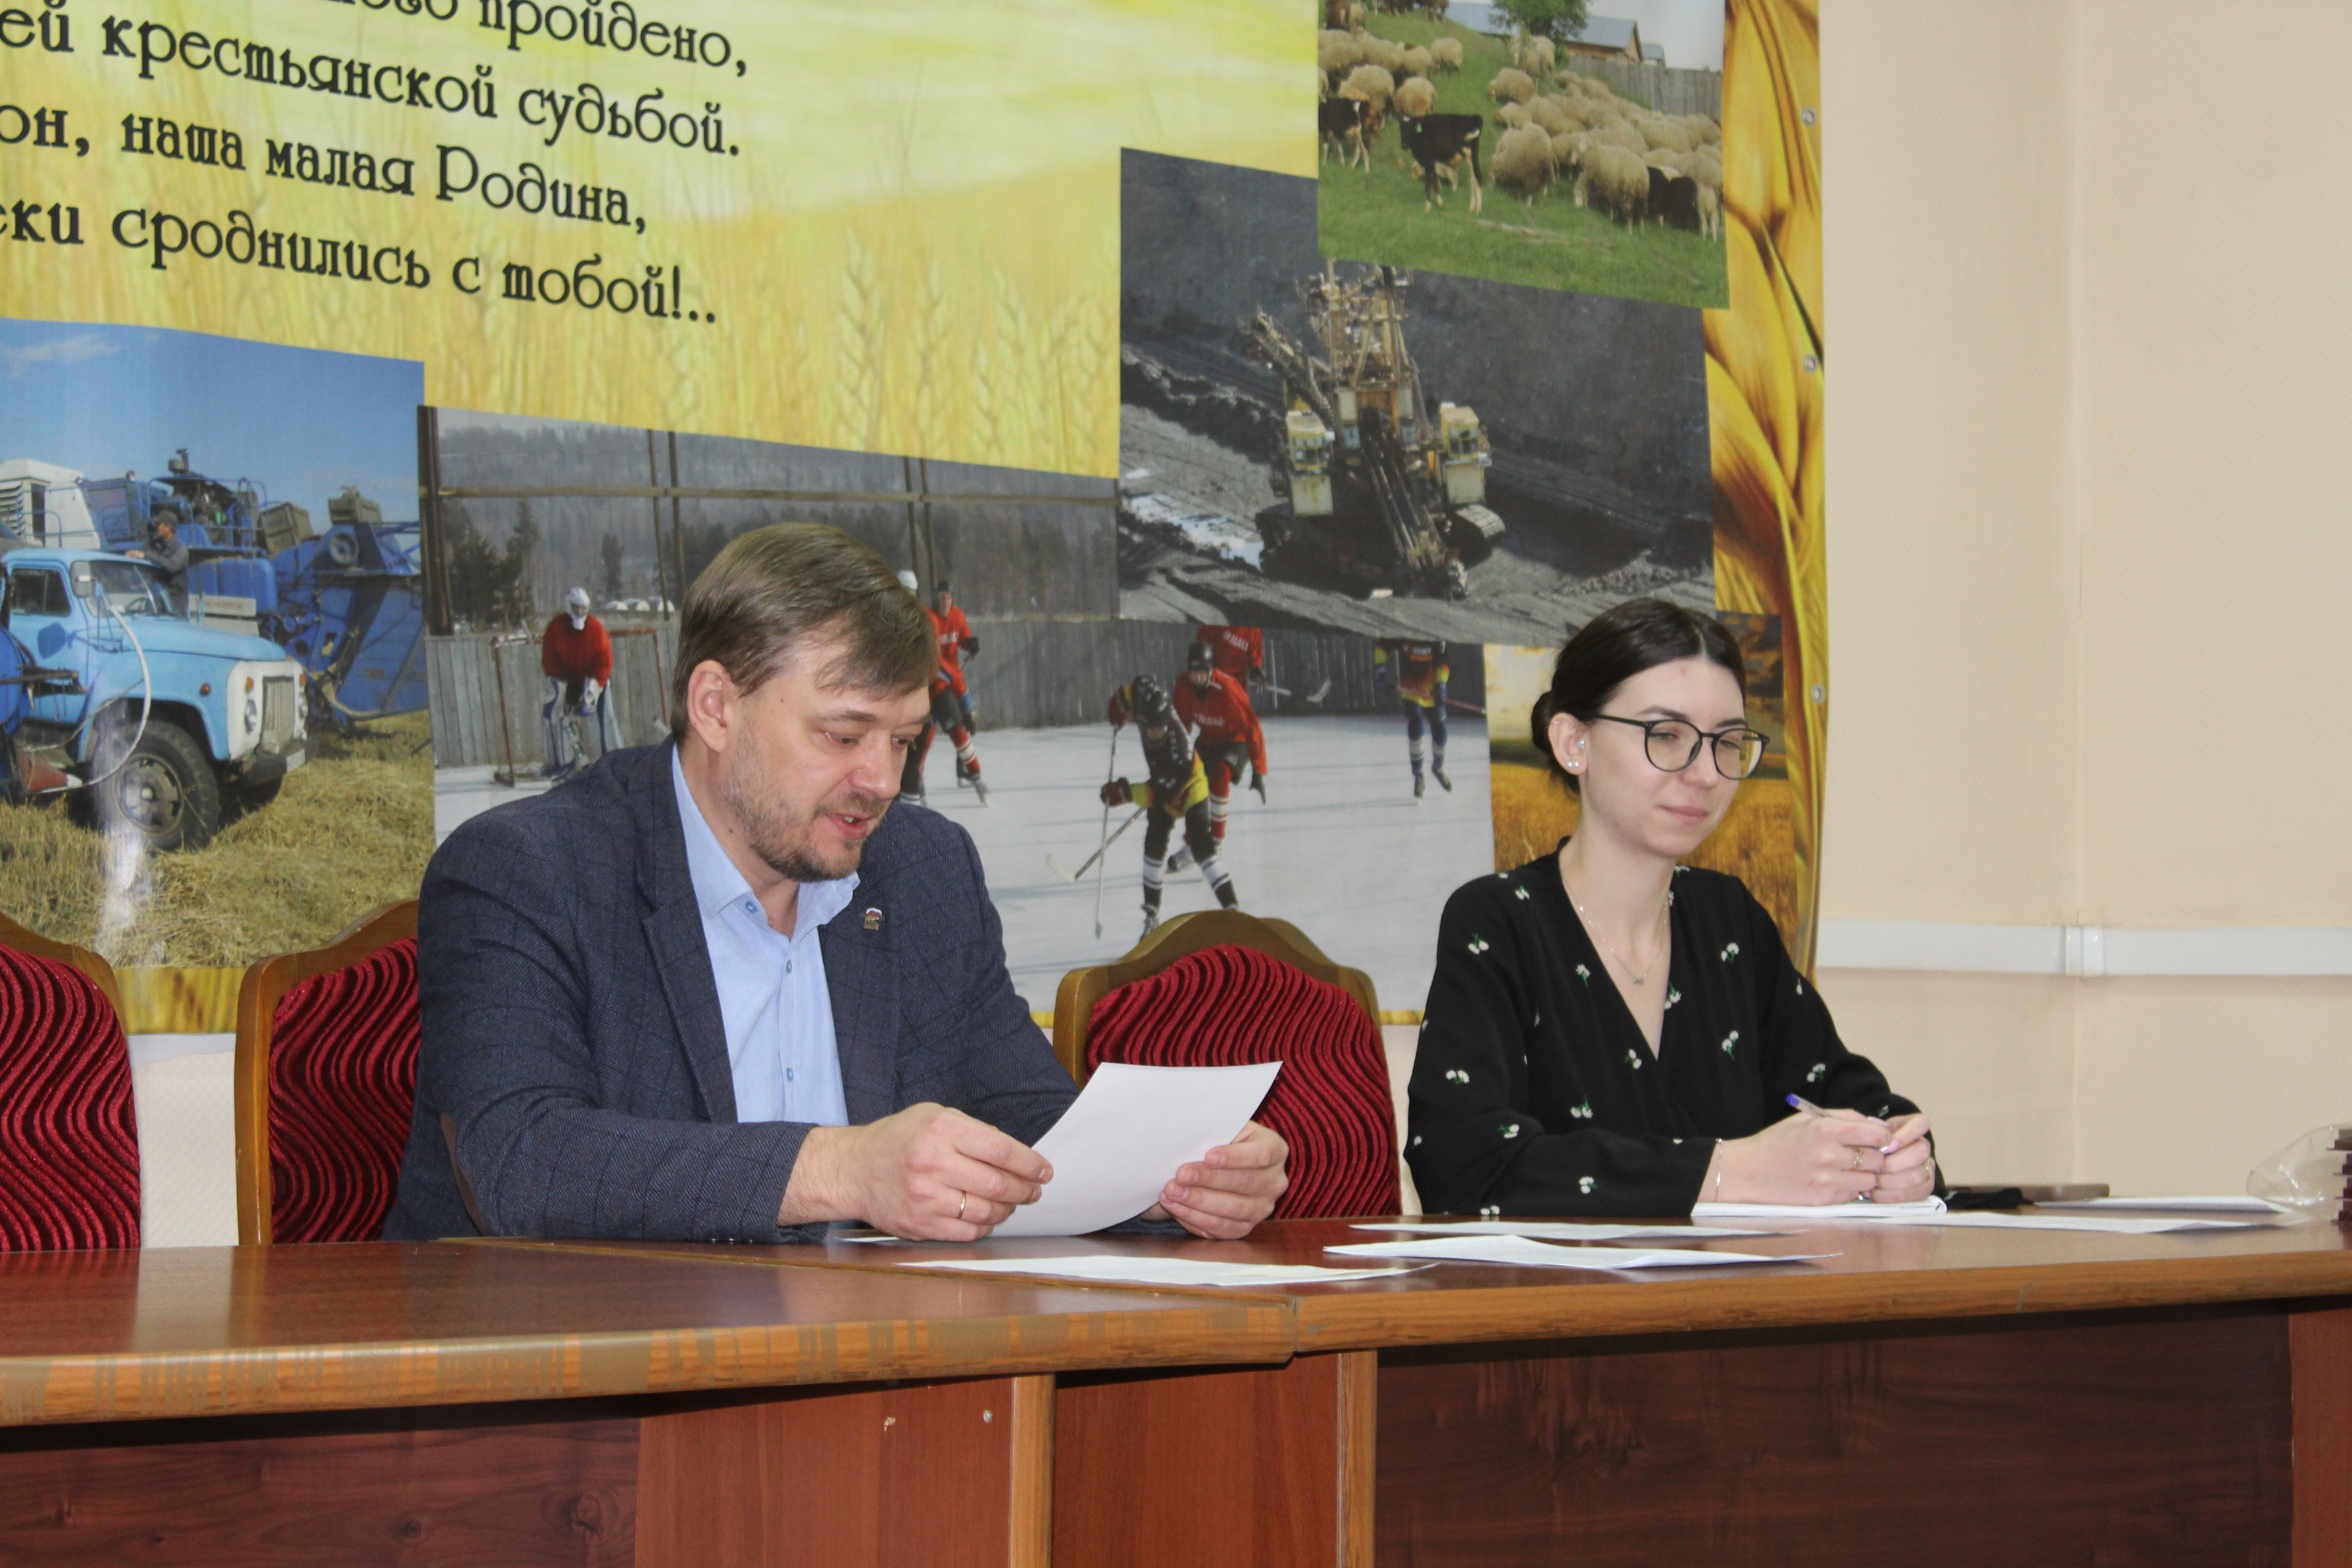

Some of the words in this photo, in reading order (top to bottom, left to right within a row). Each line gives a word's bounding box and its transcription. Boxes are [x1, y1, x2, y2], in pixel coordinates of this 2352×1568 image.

[102, 15, 498, 119] крестьянской
[519, 83, 739, 157] судьбой.
[479, 0, 746, 77] пройдено,
[0, 105, 90, 157] он,
[121, 113, 246, 171] наша
[265, 139, 415, 196] малая
[436, 145, 646, 235] Родина,
[0, 200, 84, 245] ки
[112, 209, 430, 289] сроднились
[452, 257, 481, 294] с
[502, 253, 715, 323] тобой!..
